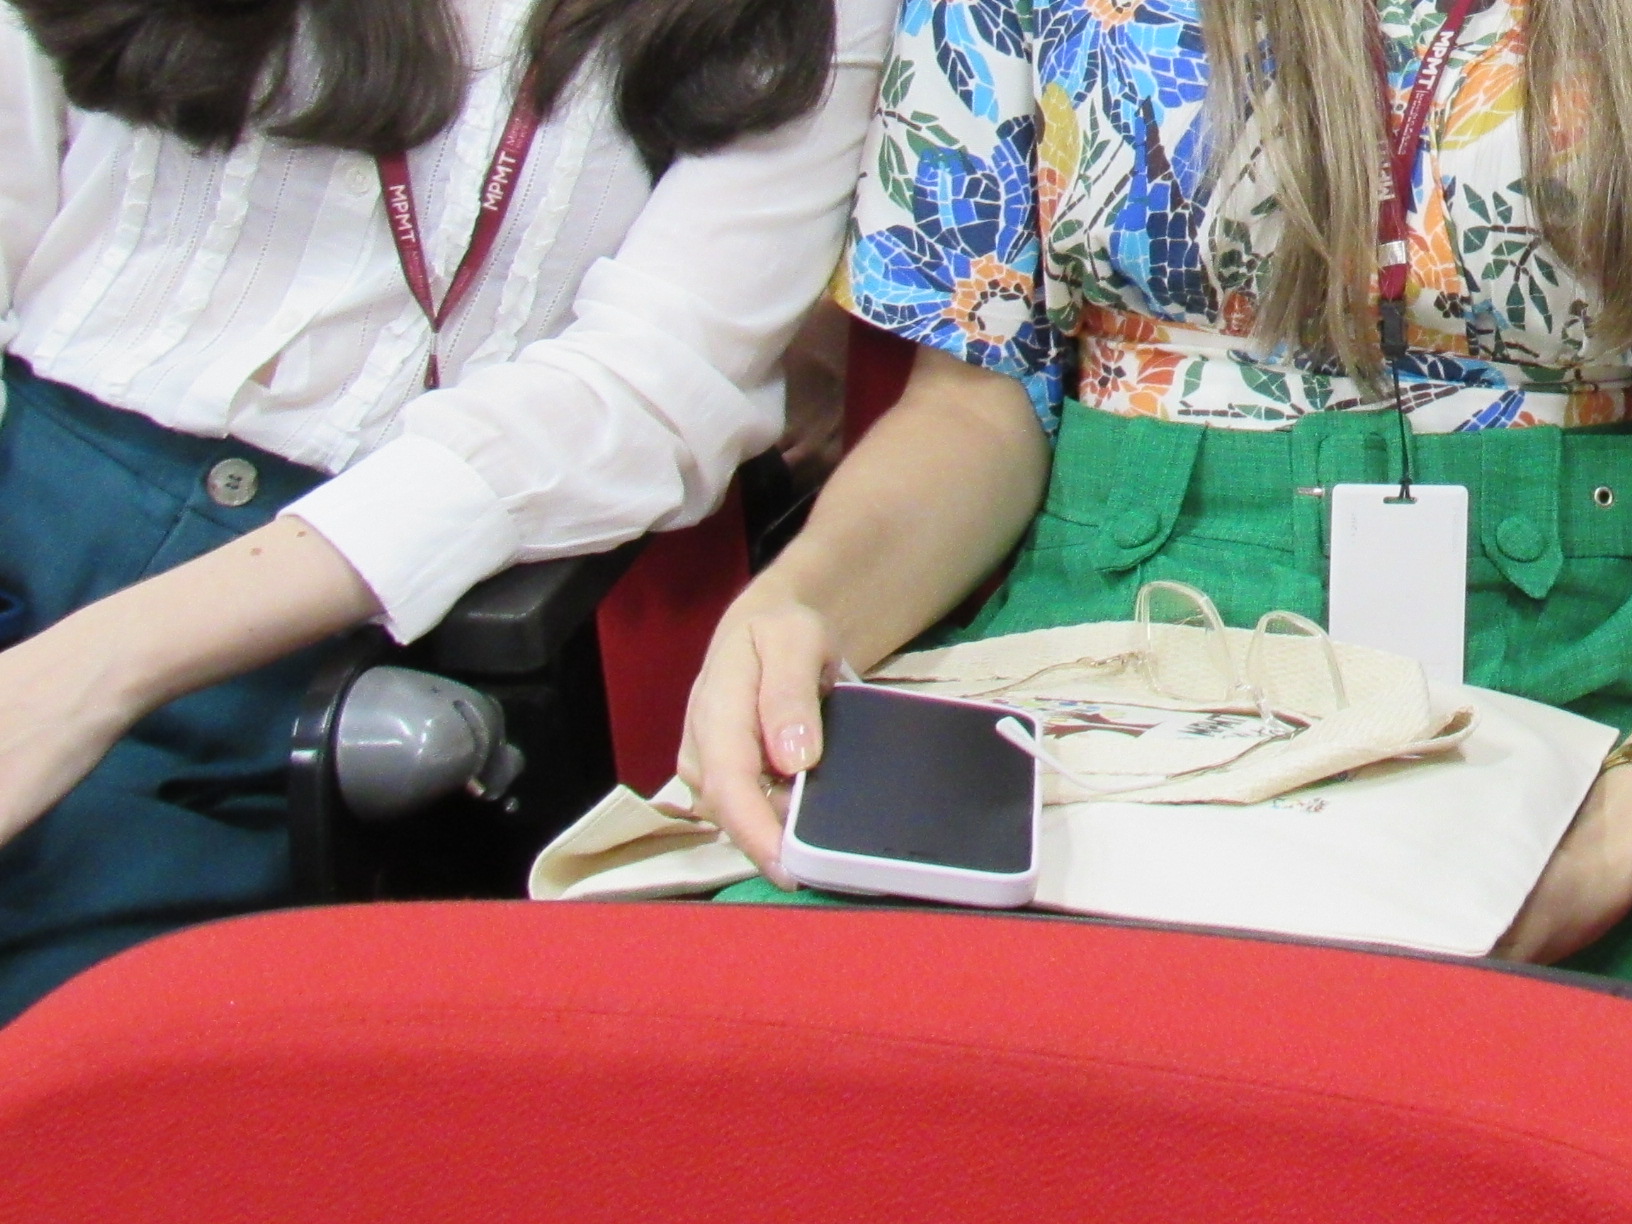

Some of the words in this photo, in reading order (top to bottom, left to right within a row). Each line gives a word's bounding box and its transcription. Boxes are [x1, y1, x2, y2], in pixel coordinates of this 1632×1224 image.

[1418, 30, 1455, 90] MPMT
[483, 150, 517, 211] MPMT
[389, 184, 416, 243] MPMT
